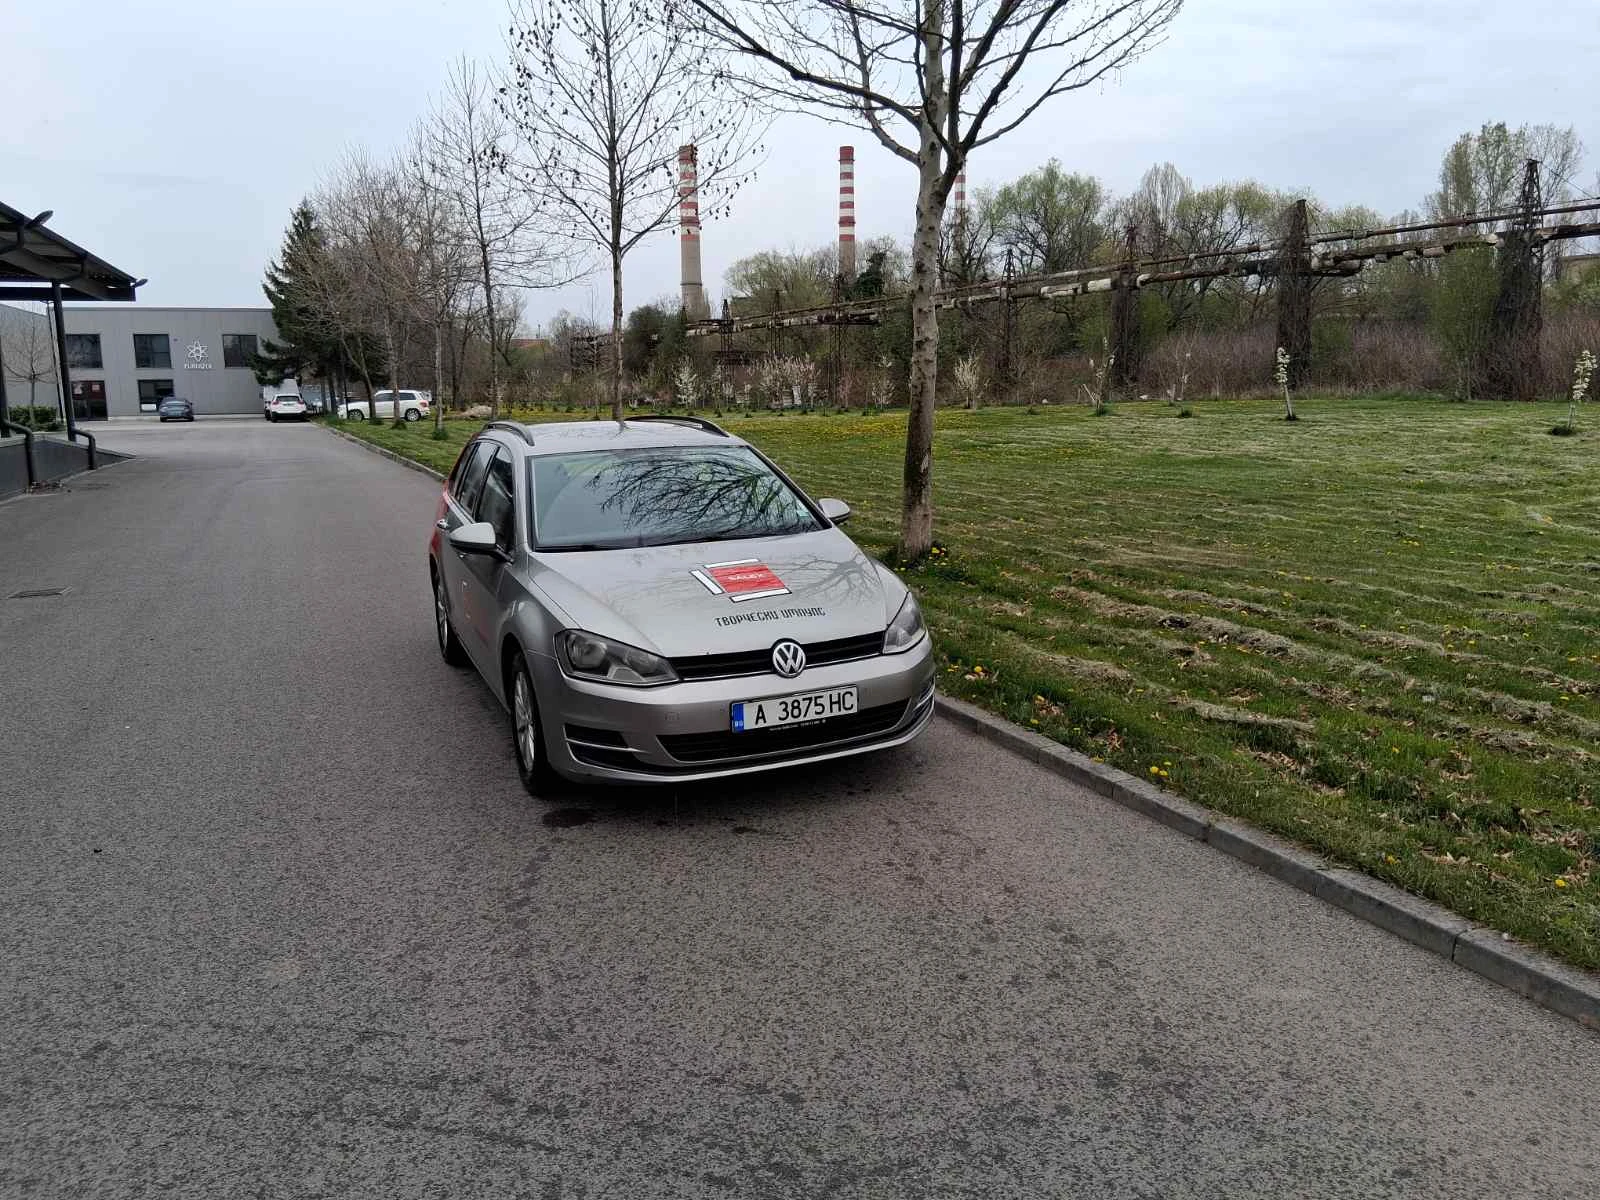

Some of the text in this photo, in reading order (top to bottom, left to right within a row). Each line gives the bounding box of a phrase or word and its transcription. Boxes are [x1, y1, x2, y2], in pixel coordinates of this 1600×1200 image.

[714, 607, 826, 627] ТВОРЧЕСКИ ИМПУЛС
[755, 704, 767, 725] A
[778, 696, 825, 721] 3875
[829, 691, 854, 713] HC
